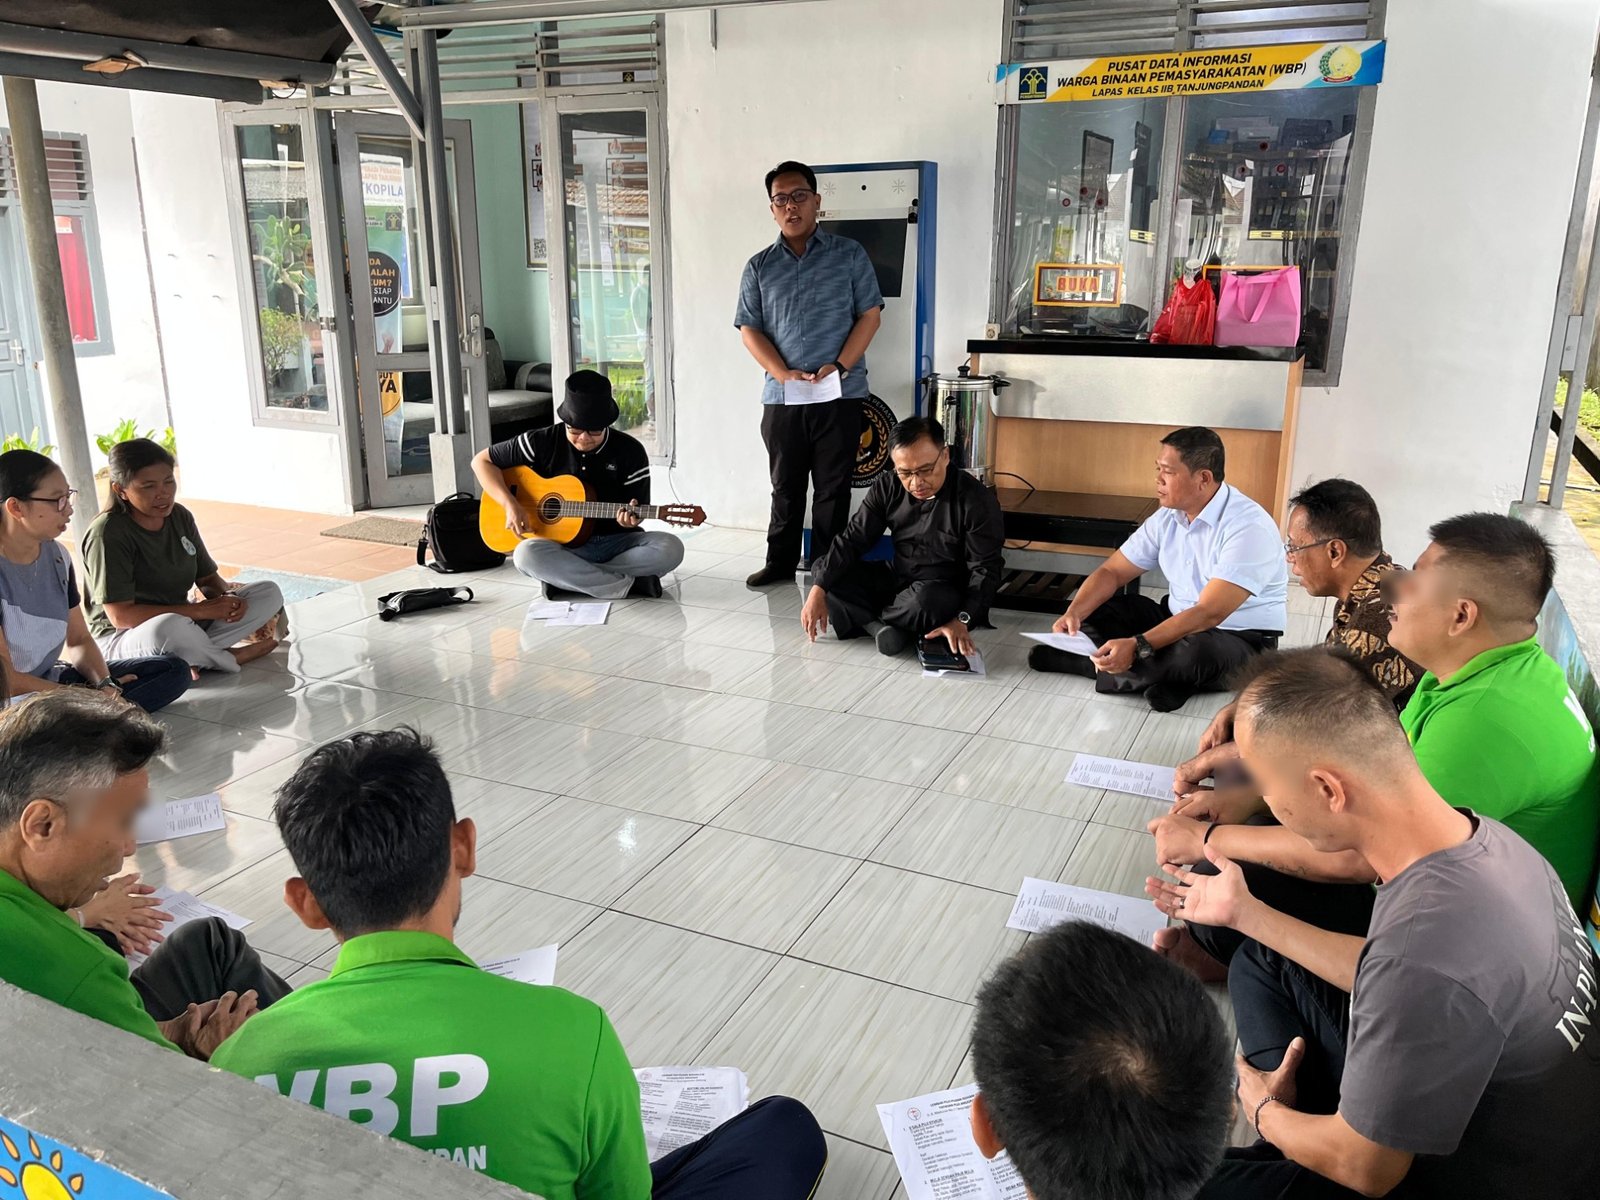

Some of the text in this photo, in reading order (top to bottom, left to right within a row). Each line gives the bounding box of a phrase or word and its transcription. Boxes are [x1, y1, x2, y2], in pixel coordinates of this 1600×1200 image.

[1107, 52, 1252, 72] PUSAT DATA INFORMASI
[1057, 62, 1307, 88] WARGA BINAAN PEMASYARAKATAN (WBP)
[1091, 78, 1264, 97] LAPAS KELAS IIB TANJUNGPANDAN
[365, 182, 404, 197] KOPILA
[369, 257, 381, 265] DA
[370, 268, 396, 277] ALAH
[371, 278, 392, 287] UM?
[1057, 277, 1099, 291] BUKA
[373, 287, 392, 295] SIAP
[372, 296, 392, 304] ANTU
[380, 379, 397, 392] YA
